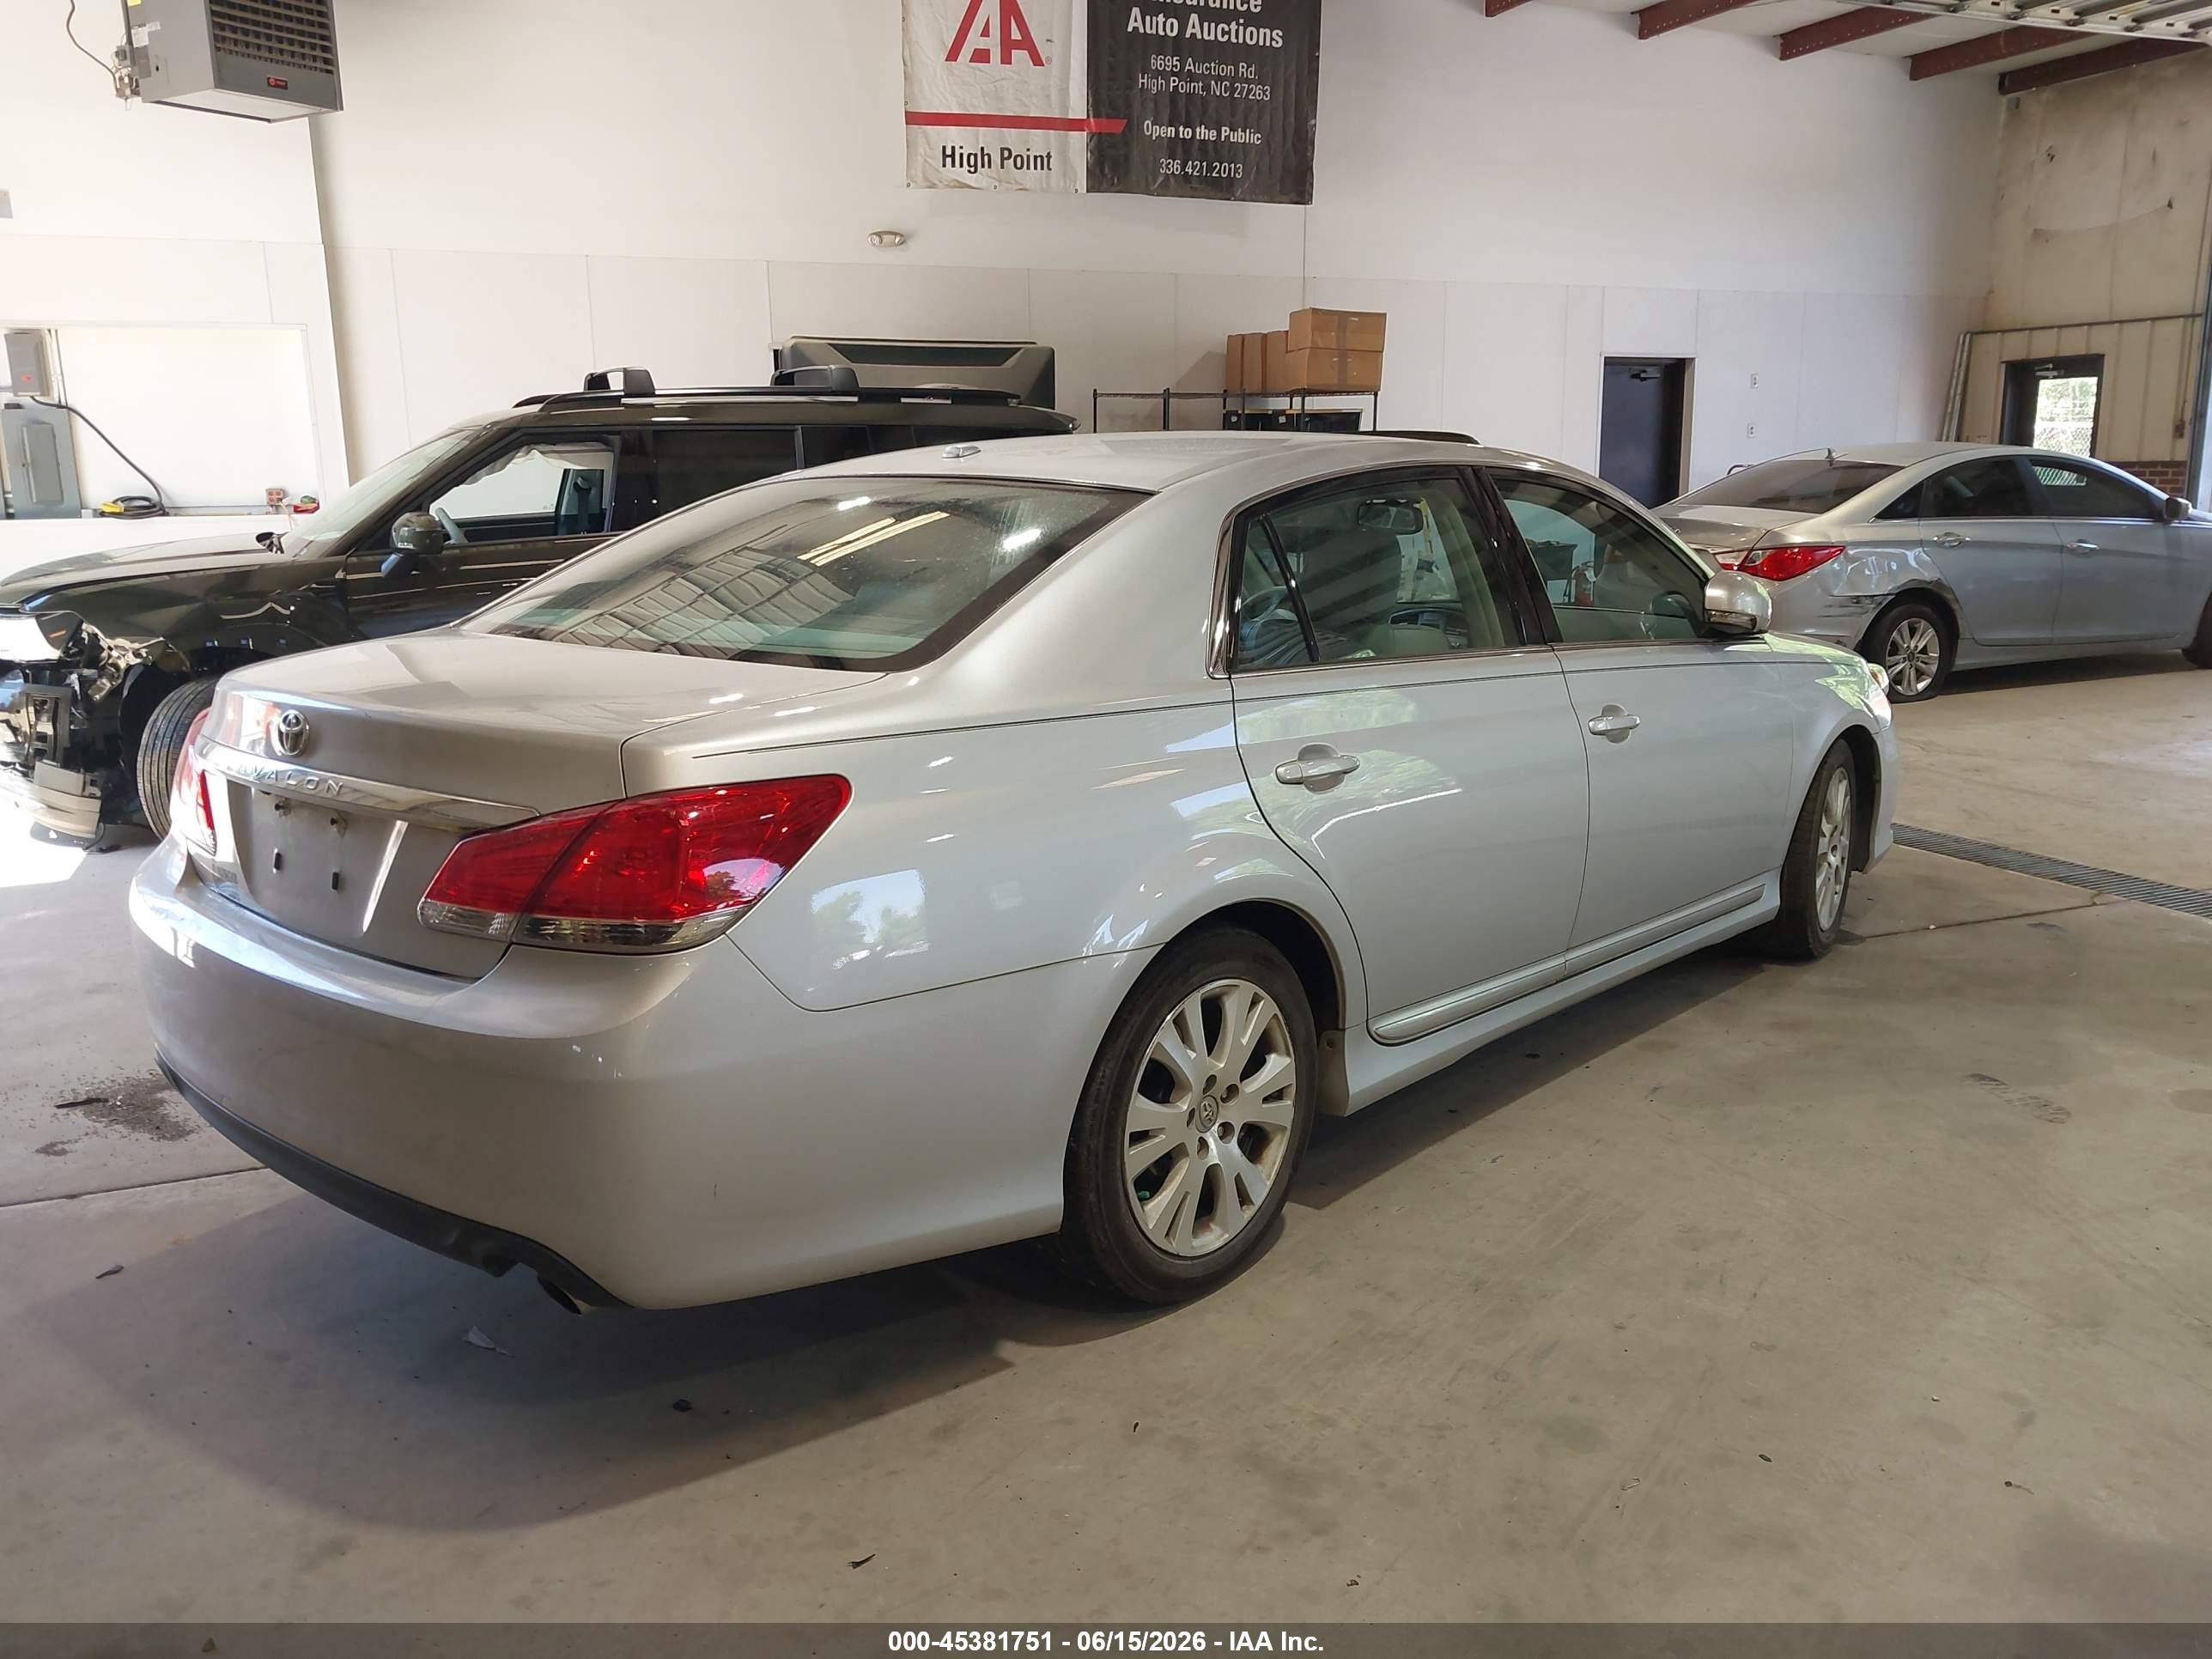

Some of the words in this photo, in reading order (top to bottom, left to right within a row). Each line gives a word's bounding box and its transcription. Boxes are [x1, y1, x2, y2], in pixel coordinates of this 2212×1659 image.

[1127, 7, 1179, 38] Auto
[1185, 13, 1284, 48] Auctions
[1151, 54, 1181, 72] 6695
[1185, 58, 1235, 77] Auction
[1238, 63, 1259, 79] Rd.
[1139, 73, 1165, 94] High
[1170, 76, 1206, 97] Point,
[1211, 81, 1230, 97] NC
[1234, 83, 1271, 100] 27263
[1144, 120, 1176, 141] Open
[1179, 126, 1193, 140] to
[1195, 125, 1218, 142] the
[1221, 126, 1262, 145] Public
[941, 144, 992, 174] High
[1000, 146, 1053, 171] Point
[1159, 159, 1243, 179] 336.421.2013
